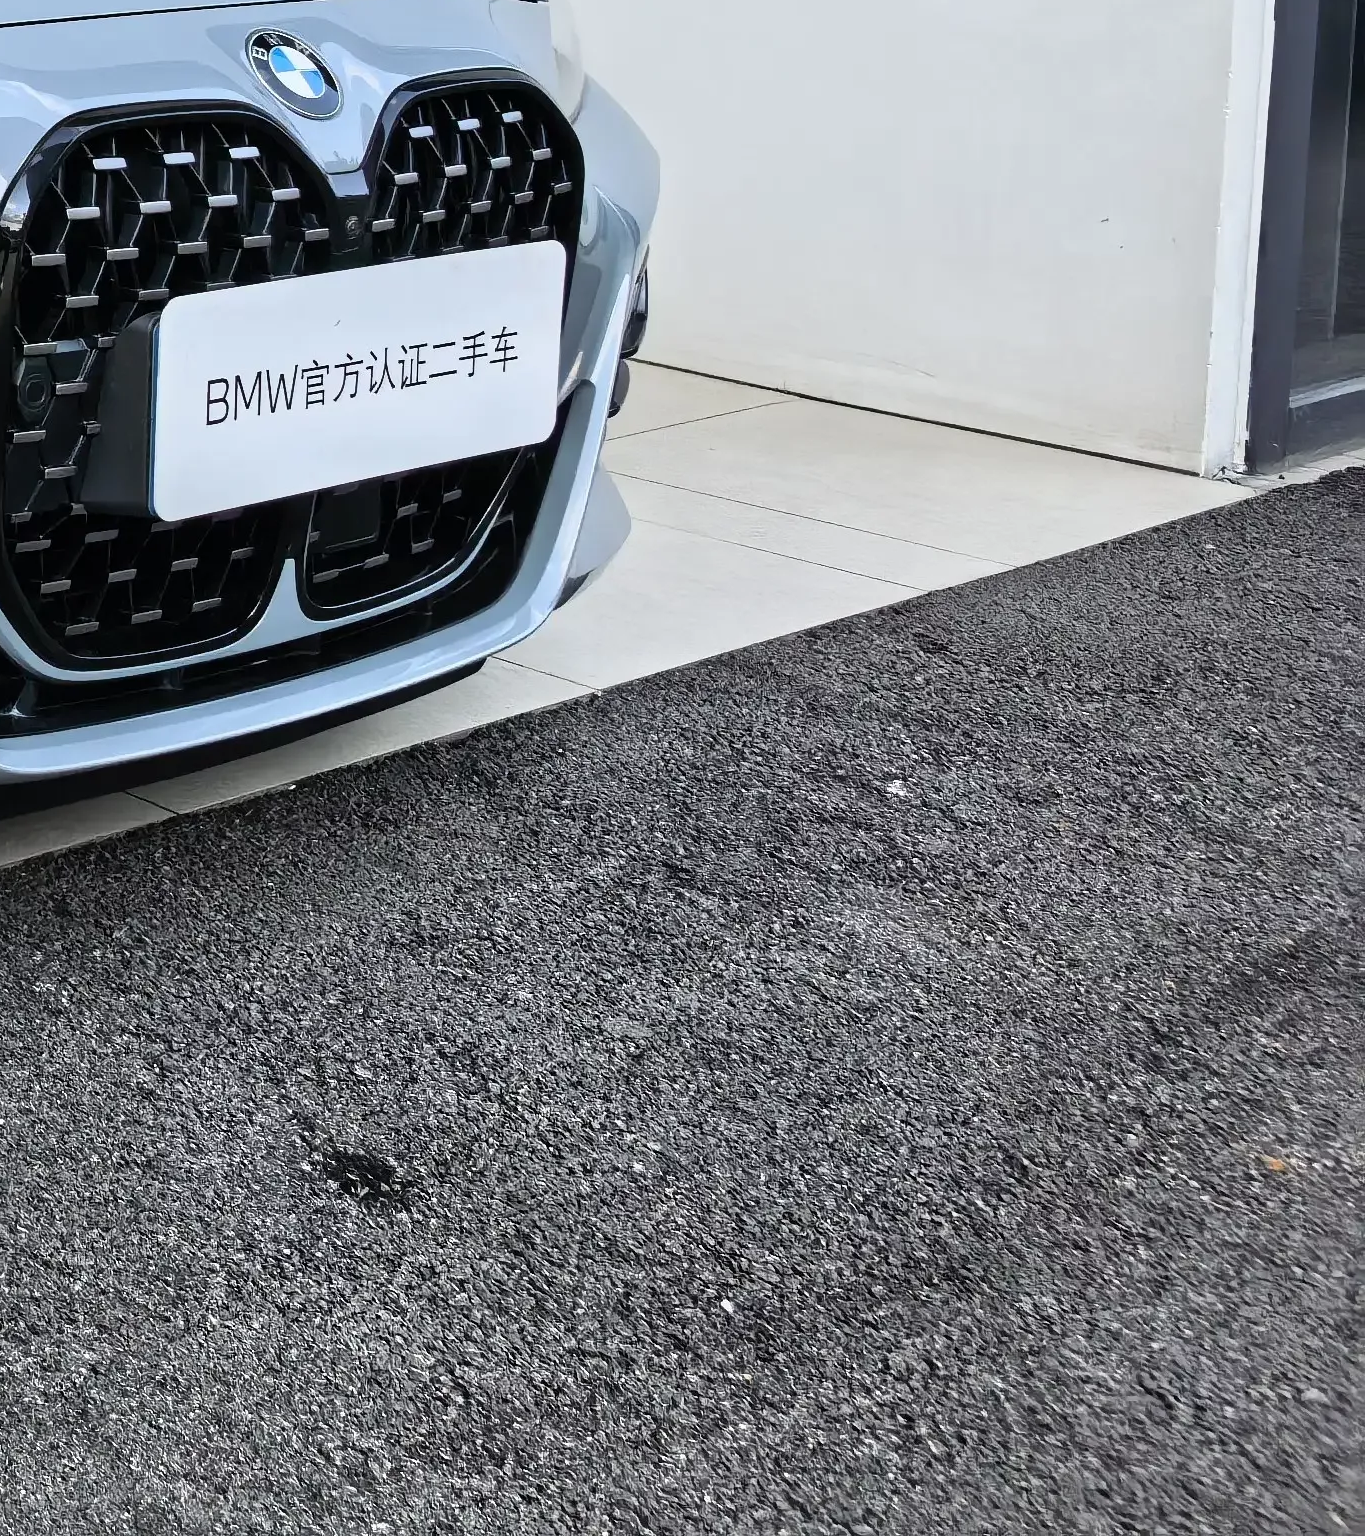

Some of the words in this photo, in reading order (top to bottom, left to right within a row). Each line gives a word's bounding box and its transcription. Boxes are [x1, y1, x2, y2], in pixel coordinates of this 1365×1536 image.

[205, 326, 519, 426] BMW官方认证二手车
